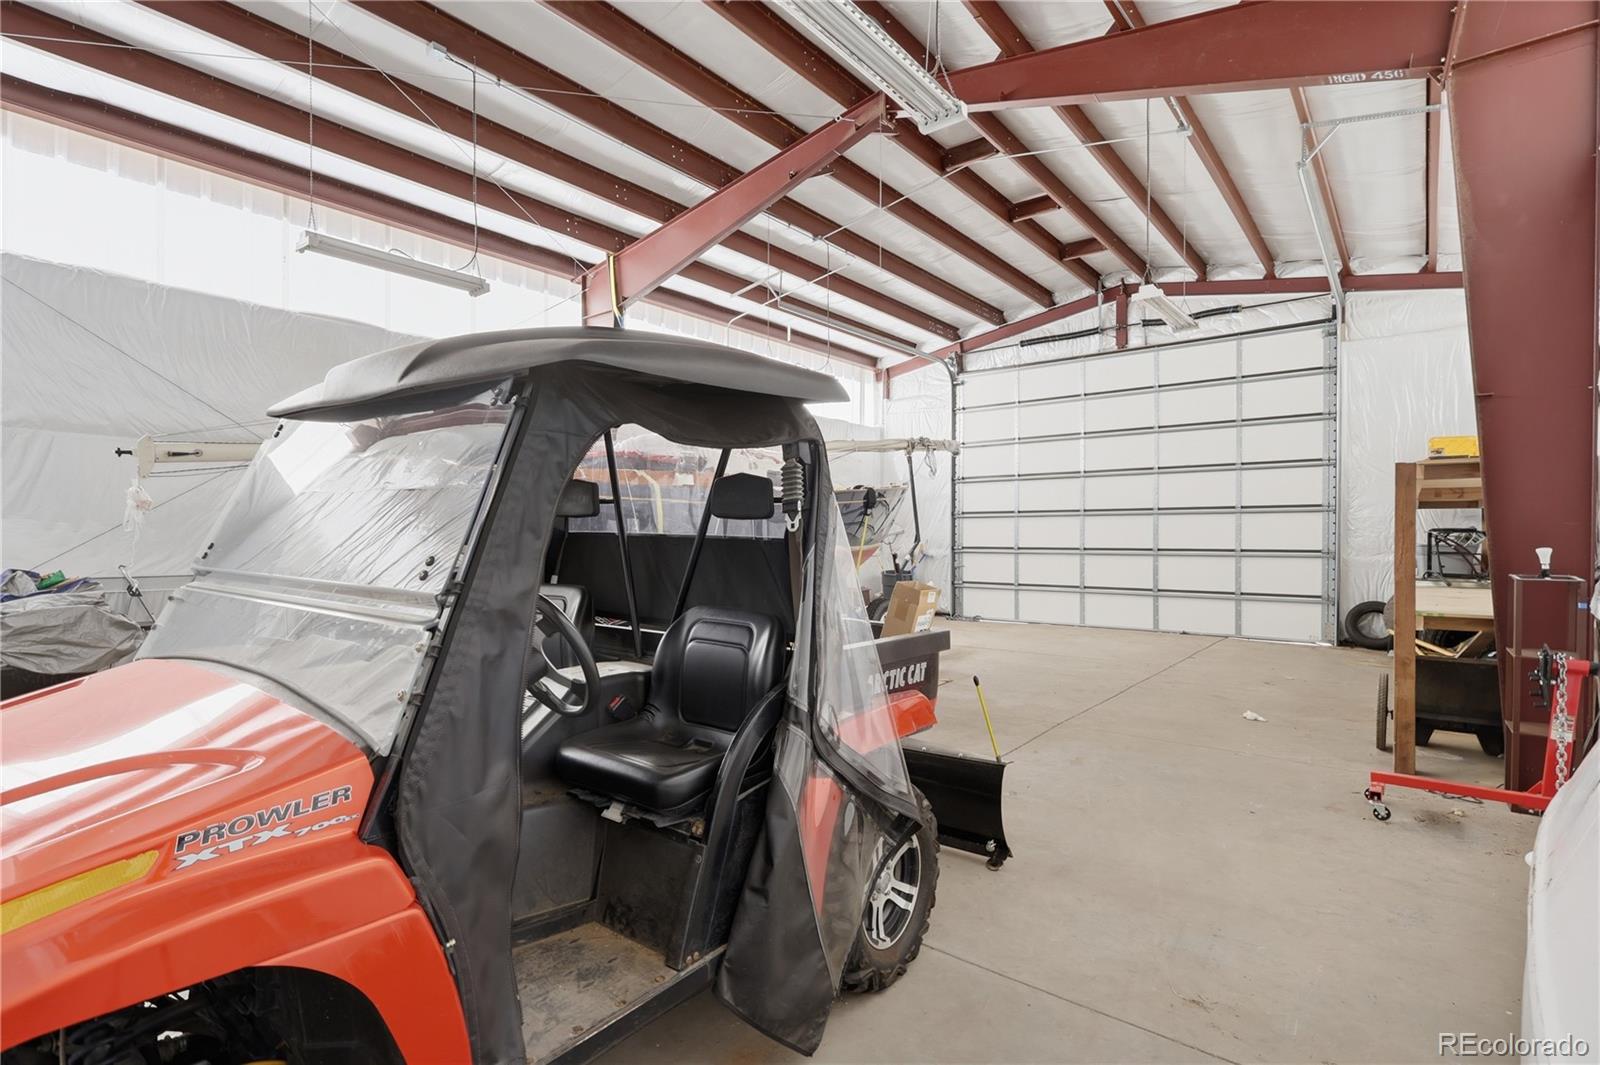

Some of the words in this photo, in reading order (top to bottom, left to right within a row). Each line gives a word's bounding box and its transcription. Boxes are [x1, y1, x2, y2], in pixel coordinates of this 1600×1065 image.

[907, 661, 927, 685] CAT
[174, 784, 353, 855] PROWLER
[175, 823, 292, 870] XTX
